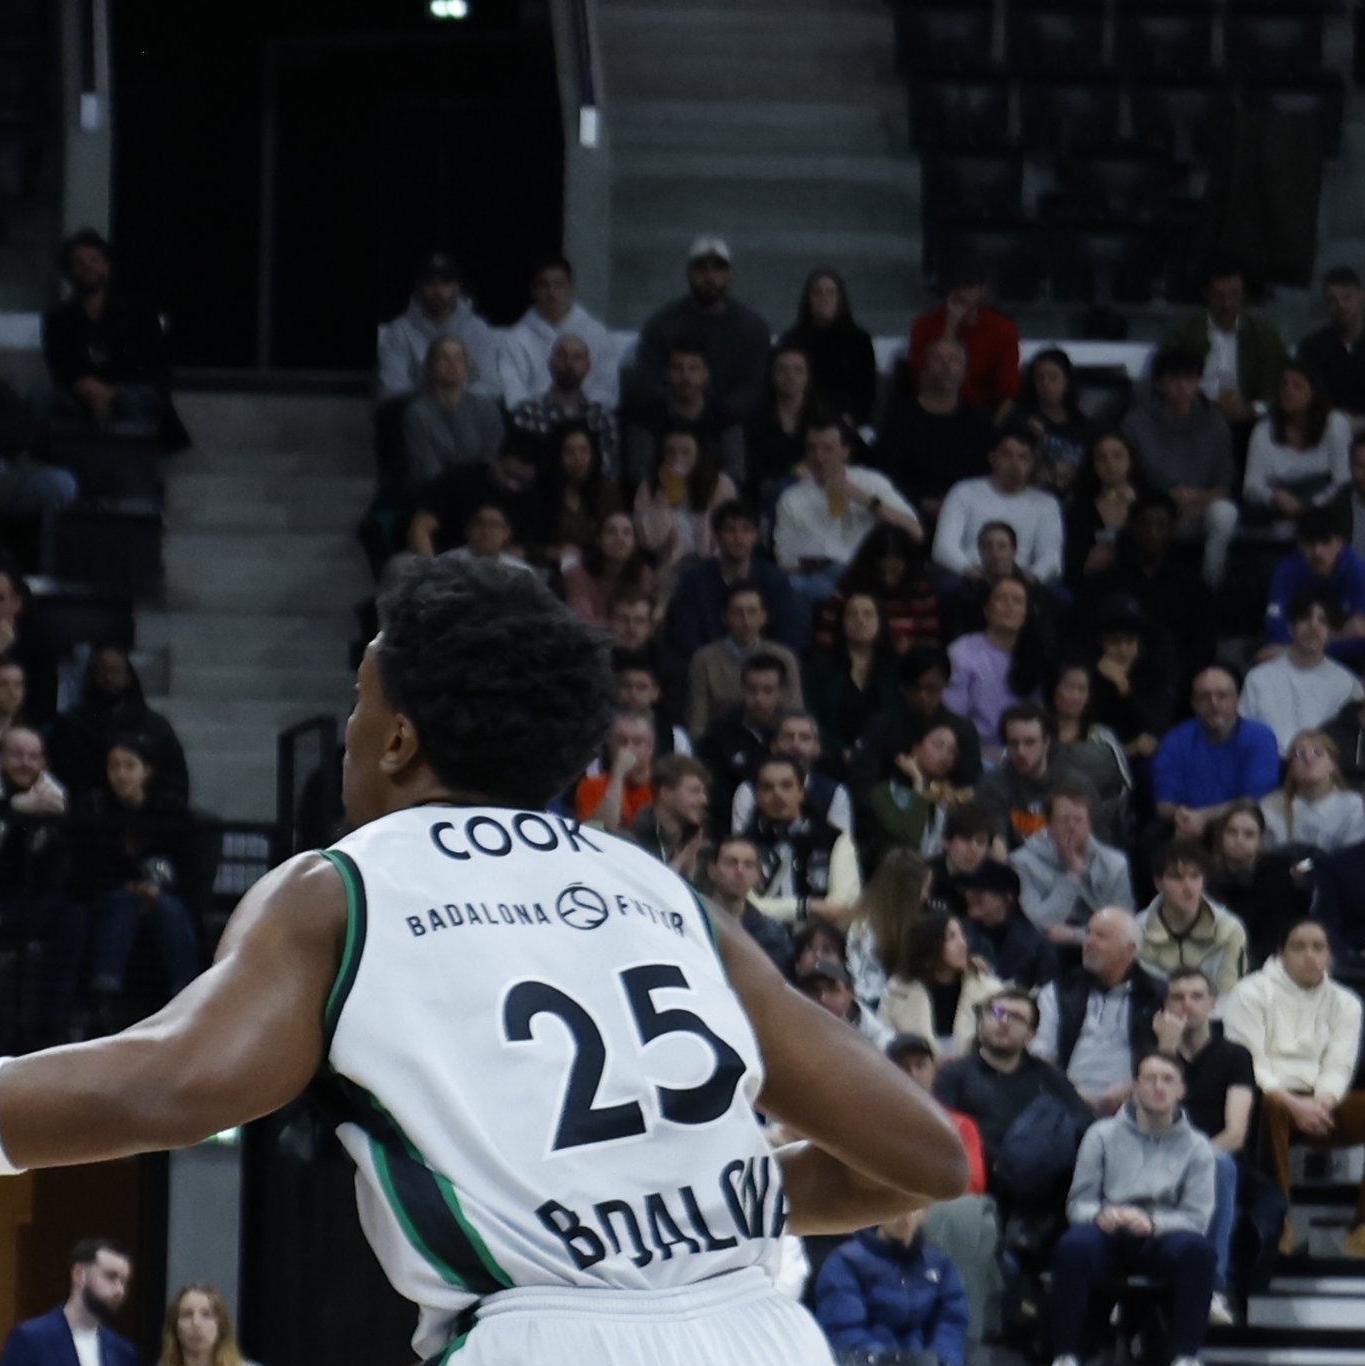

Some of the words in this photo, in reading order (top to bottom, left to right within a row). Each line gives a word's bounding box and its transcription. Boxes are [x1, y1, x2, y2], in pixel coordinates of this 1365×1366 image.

[429, 812, 604, 860] COOK
[405, 902, 551, 938] BADALONA
[502, 963, 747, 1152] 25
